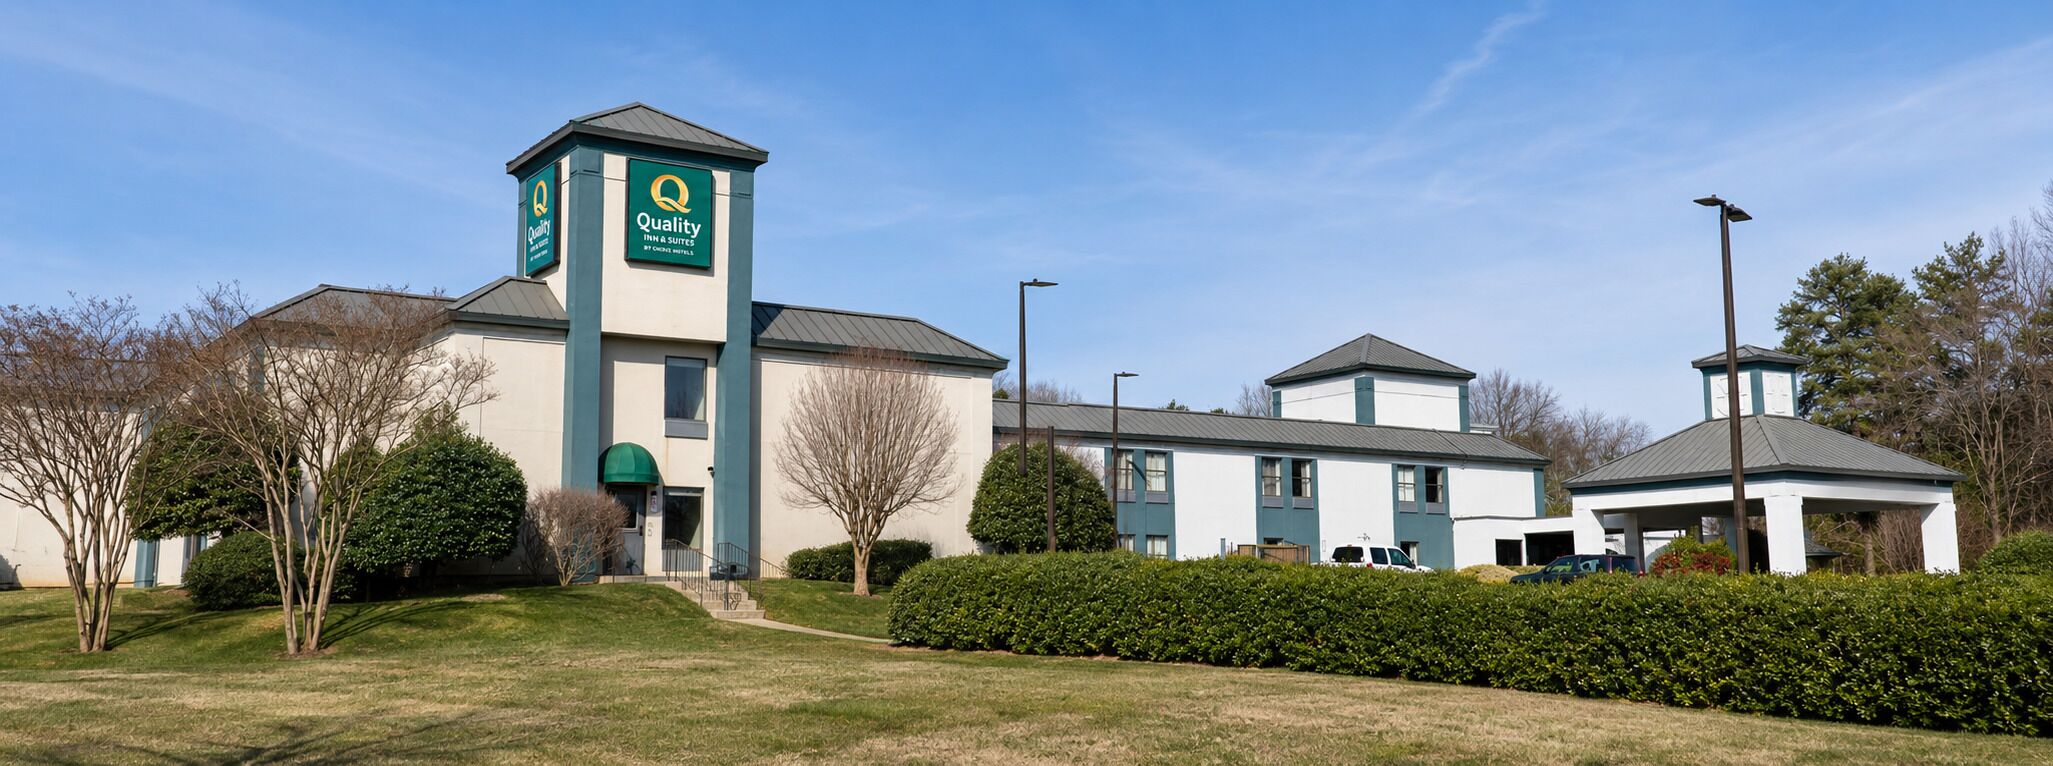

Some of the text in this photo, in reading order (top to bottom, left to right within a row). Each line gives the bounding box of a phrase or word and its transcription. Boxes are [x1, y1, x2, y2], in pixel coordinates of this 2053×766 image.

[533, 180, 548, 217] Q
[650, 174, 692, 214] Q
[637, 212, 702, 239] Quality
[667, 237, 695, 247] SUITES
